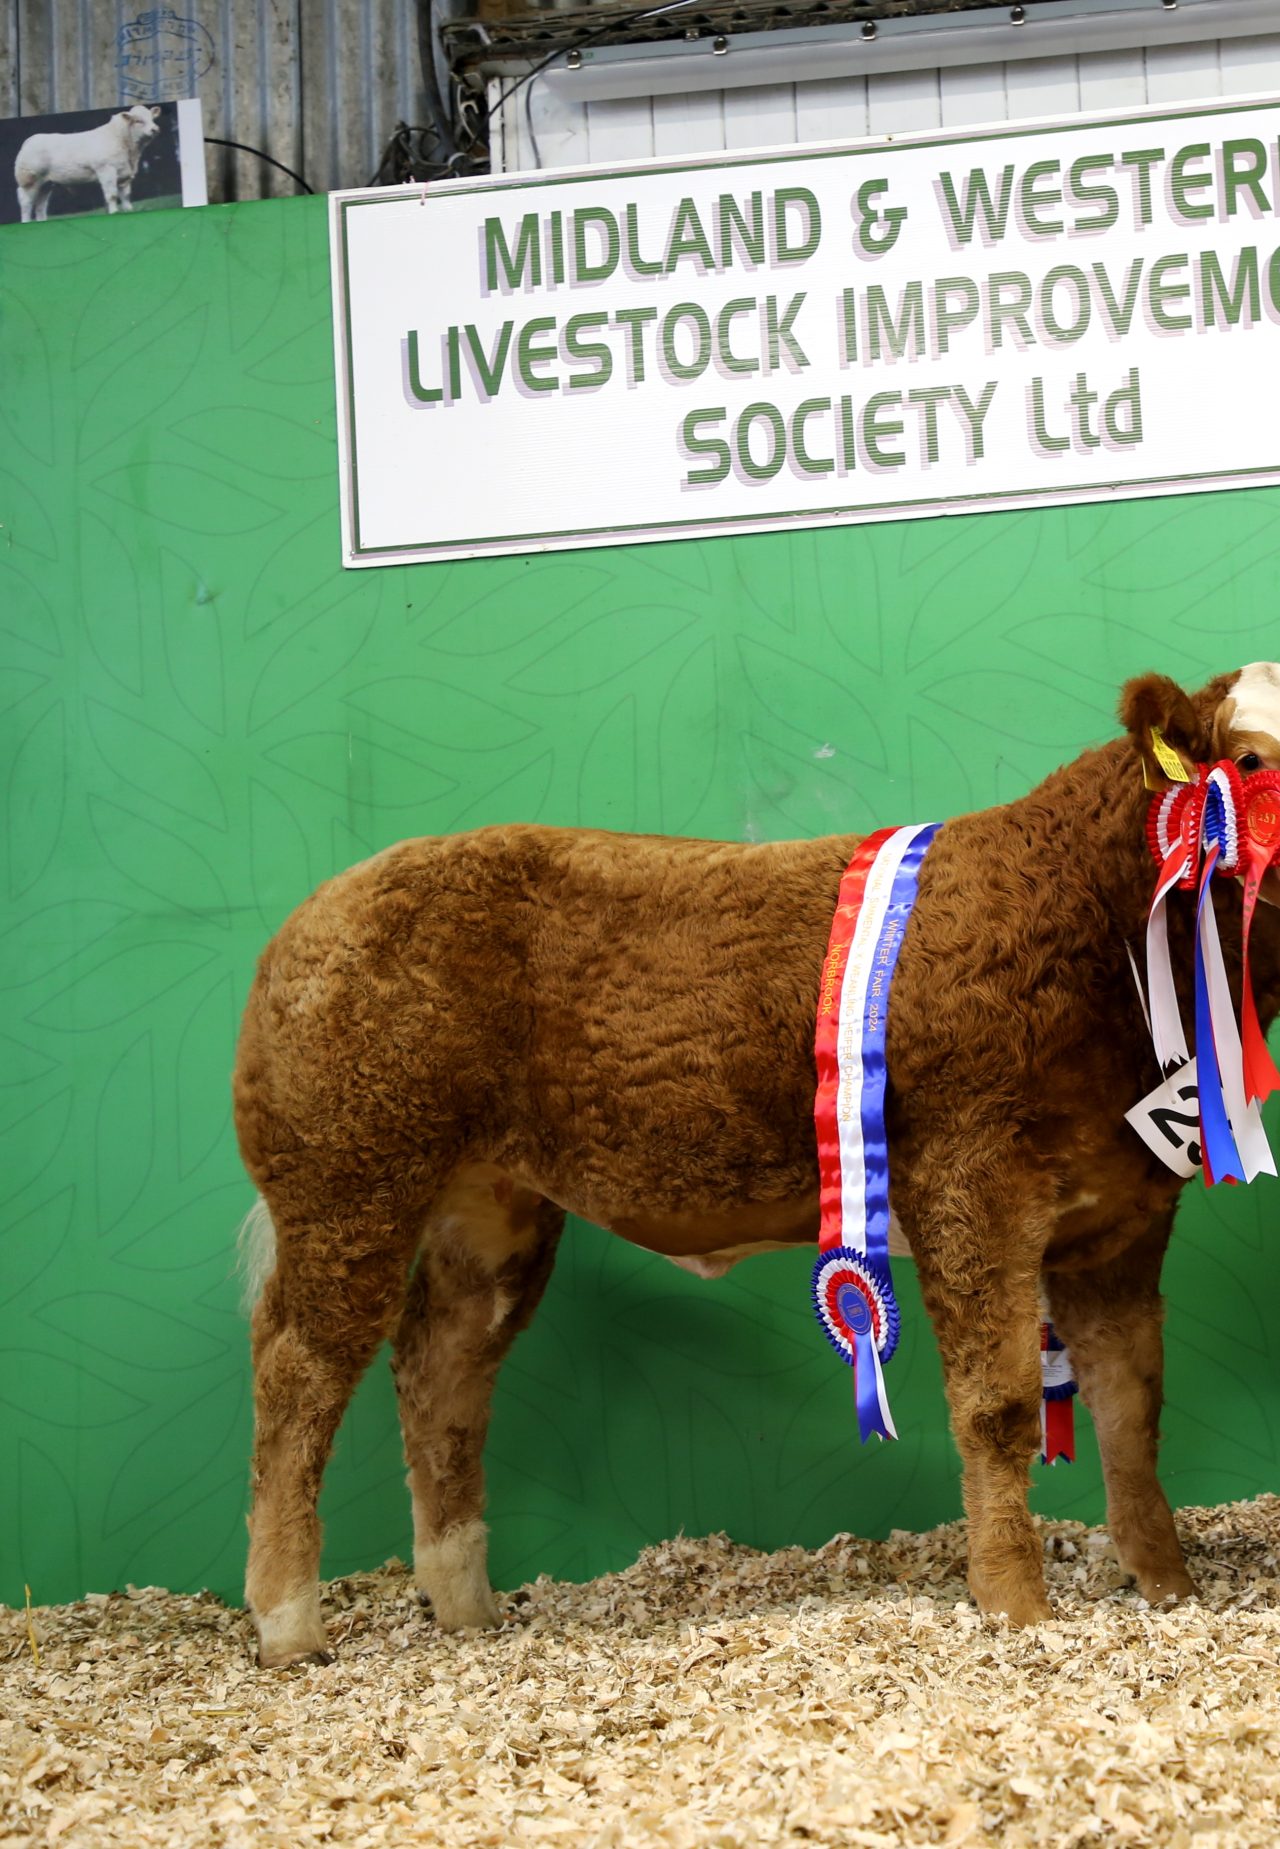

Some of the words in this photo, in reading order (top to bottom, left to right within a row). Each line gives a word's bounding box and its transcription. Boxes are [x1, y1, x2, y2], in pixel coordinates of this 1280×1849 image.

[480, 187, 822, 295] MIDLAND
[854, 178, 907, 258] &
[403, 292, 810, 407] LIVESTOCK
[677, 365, 998, 490] SOCIETY
[1027, 368, 1143, 457] Ltd
[877, 919, 899, 966] WINTER
[821, 944, 841, 1016] NORBROOK
[871, 970, 885, 998] FAIR
[868, 1003, 878, 1033] 2024
[842, 1065, 853, 1122] CHAMPION
